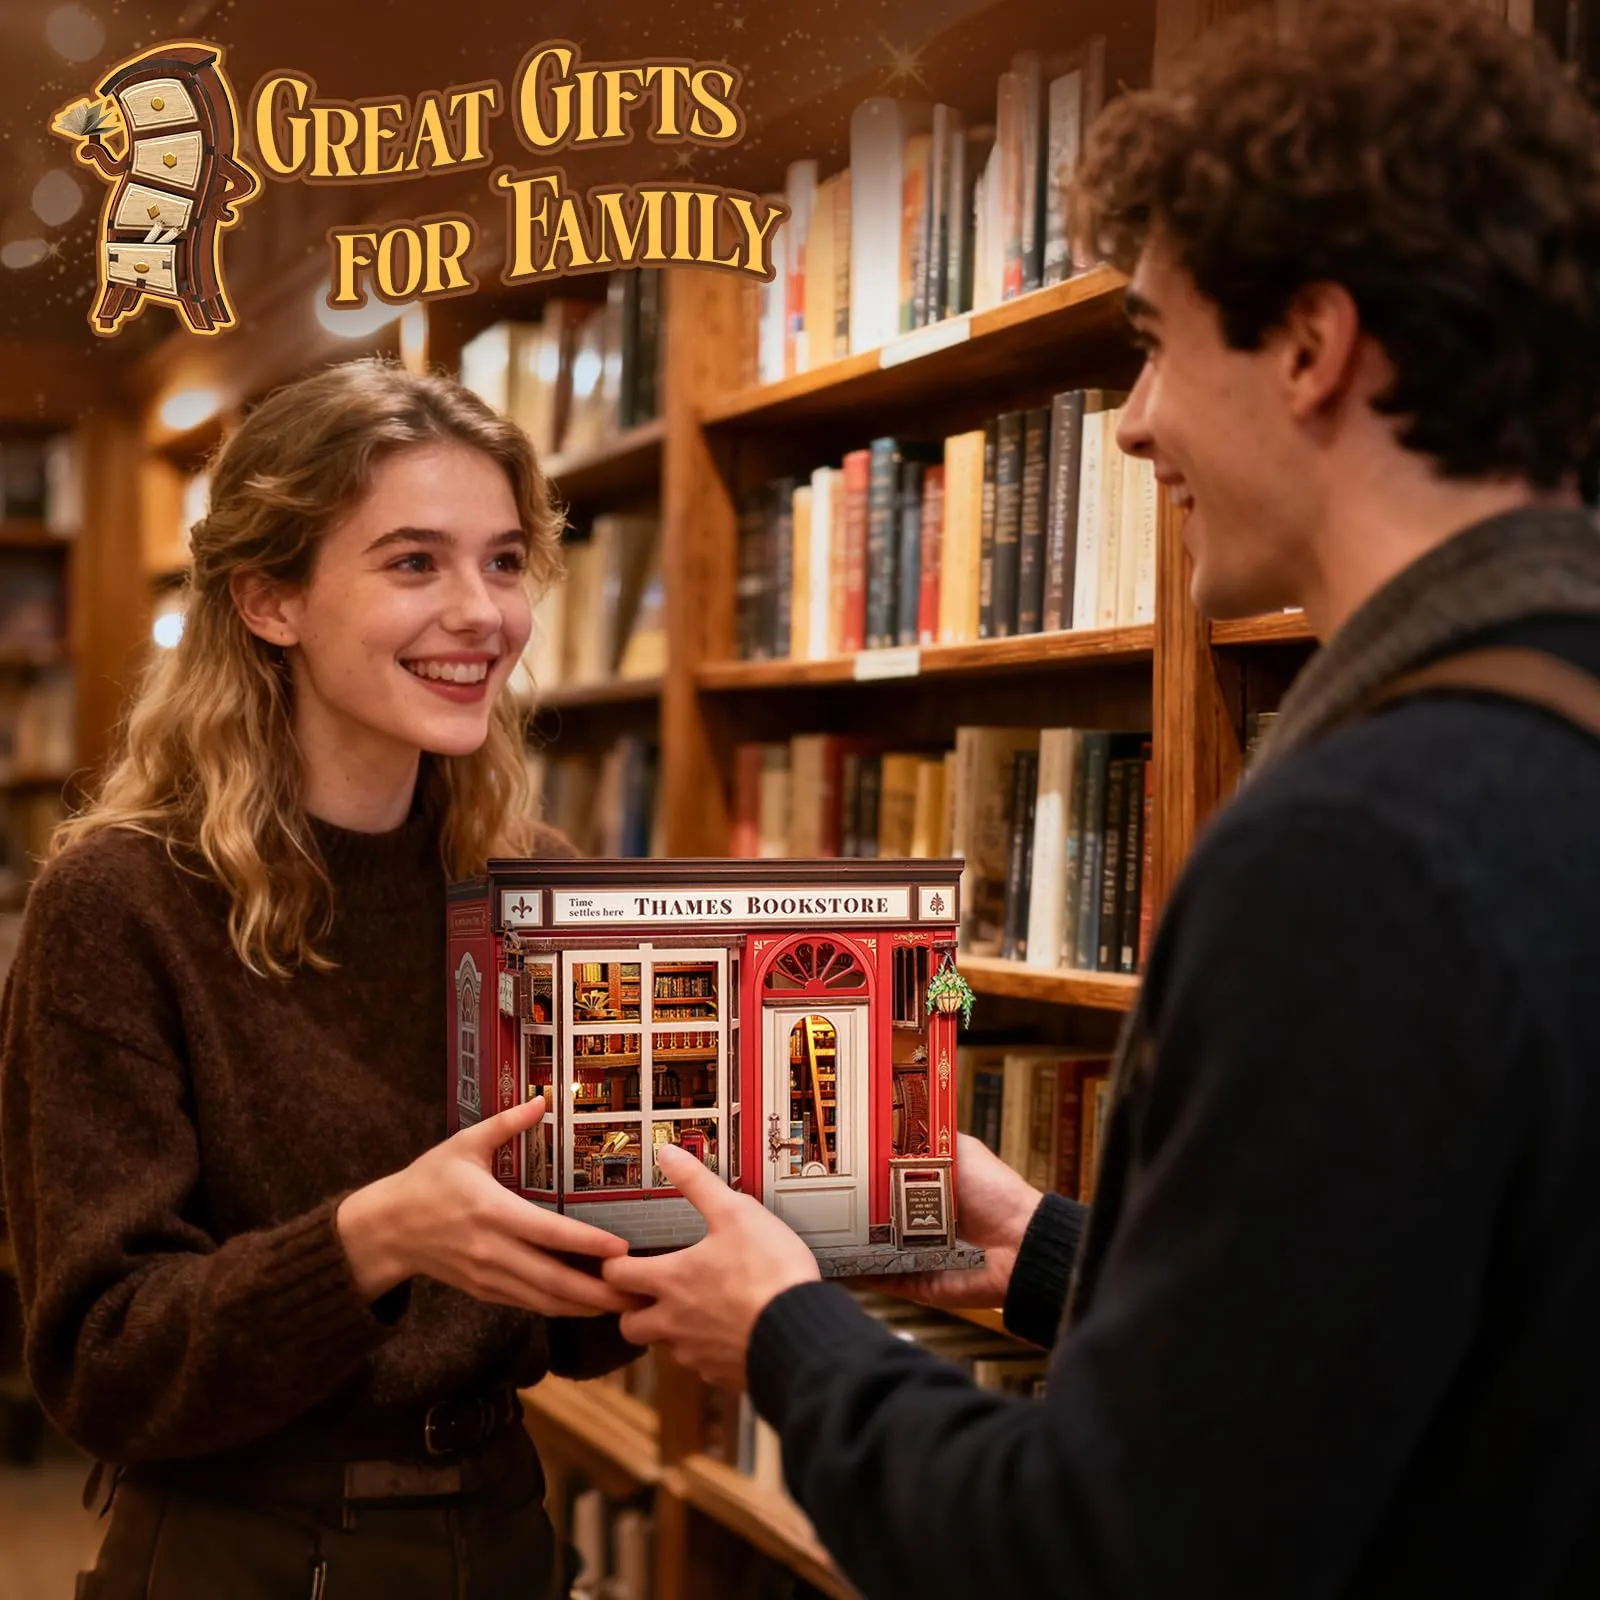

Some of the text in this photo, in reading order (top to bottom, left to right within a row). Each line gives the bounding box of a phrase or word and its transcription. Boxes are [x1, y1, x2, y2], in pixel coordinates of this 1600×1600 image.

[568, 897, 593, 907] Time
[634, 896, 889, 916] THAMES BOOKSTORE
[569, 907, 625, 917] settles here
